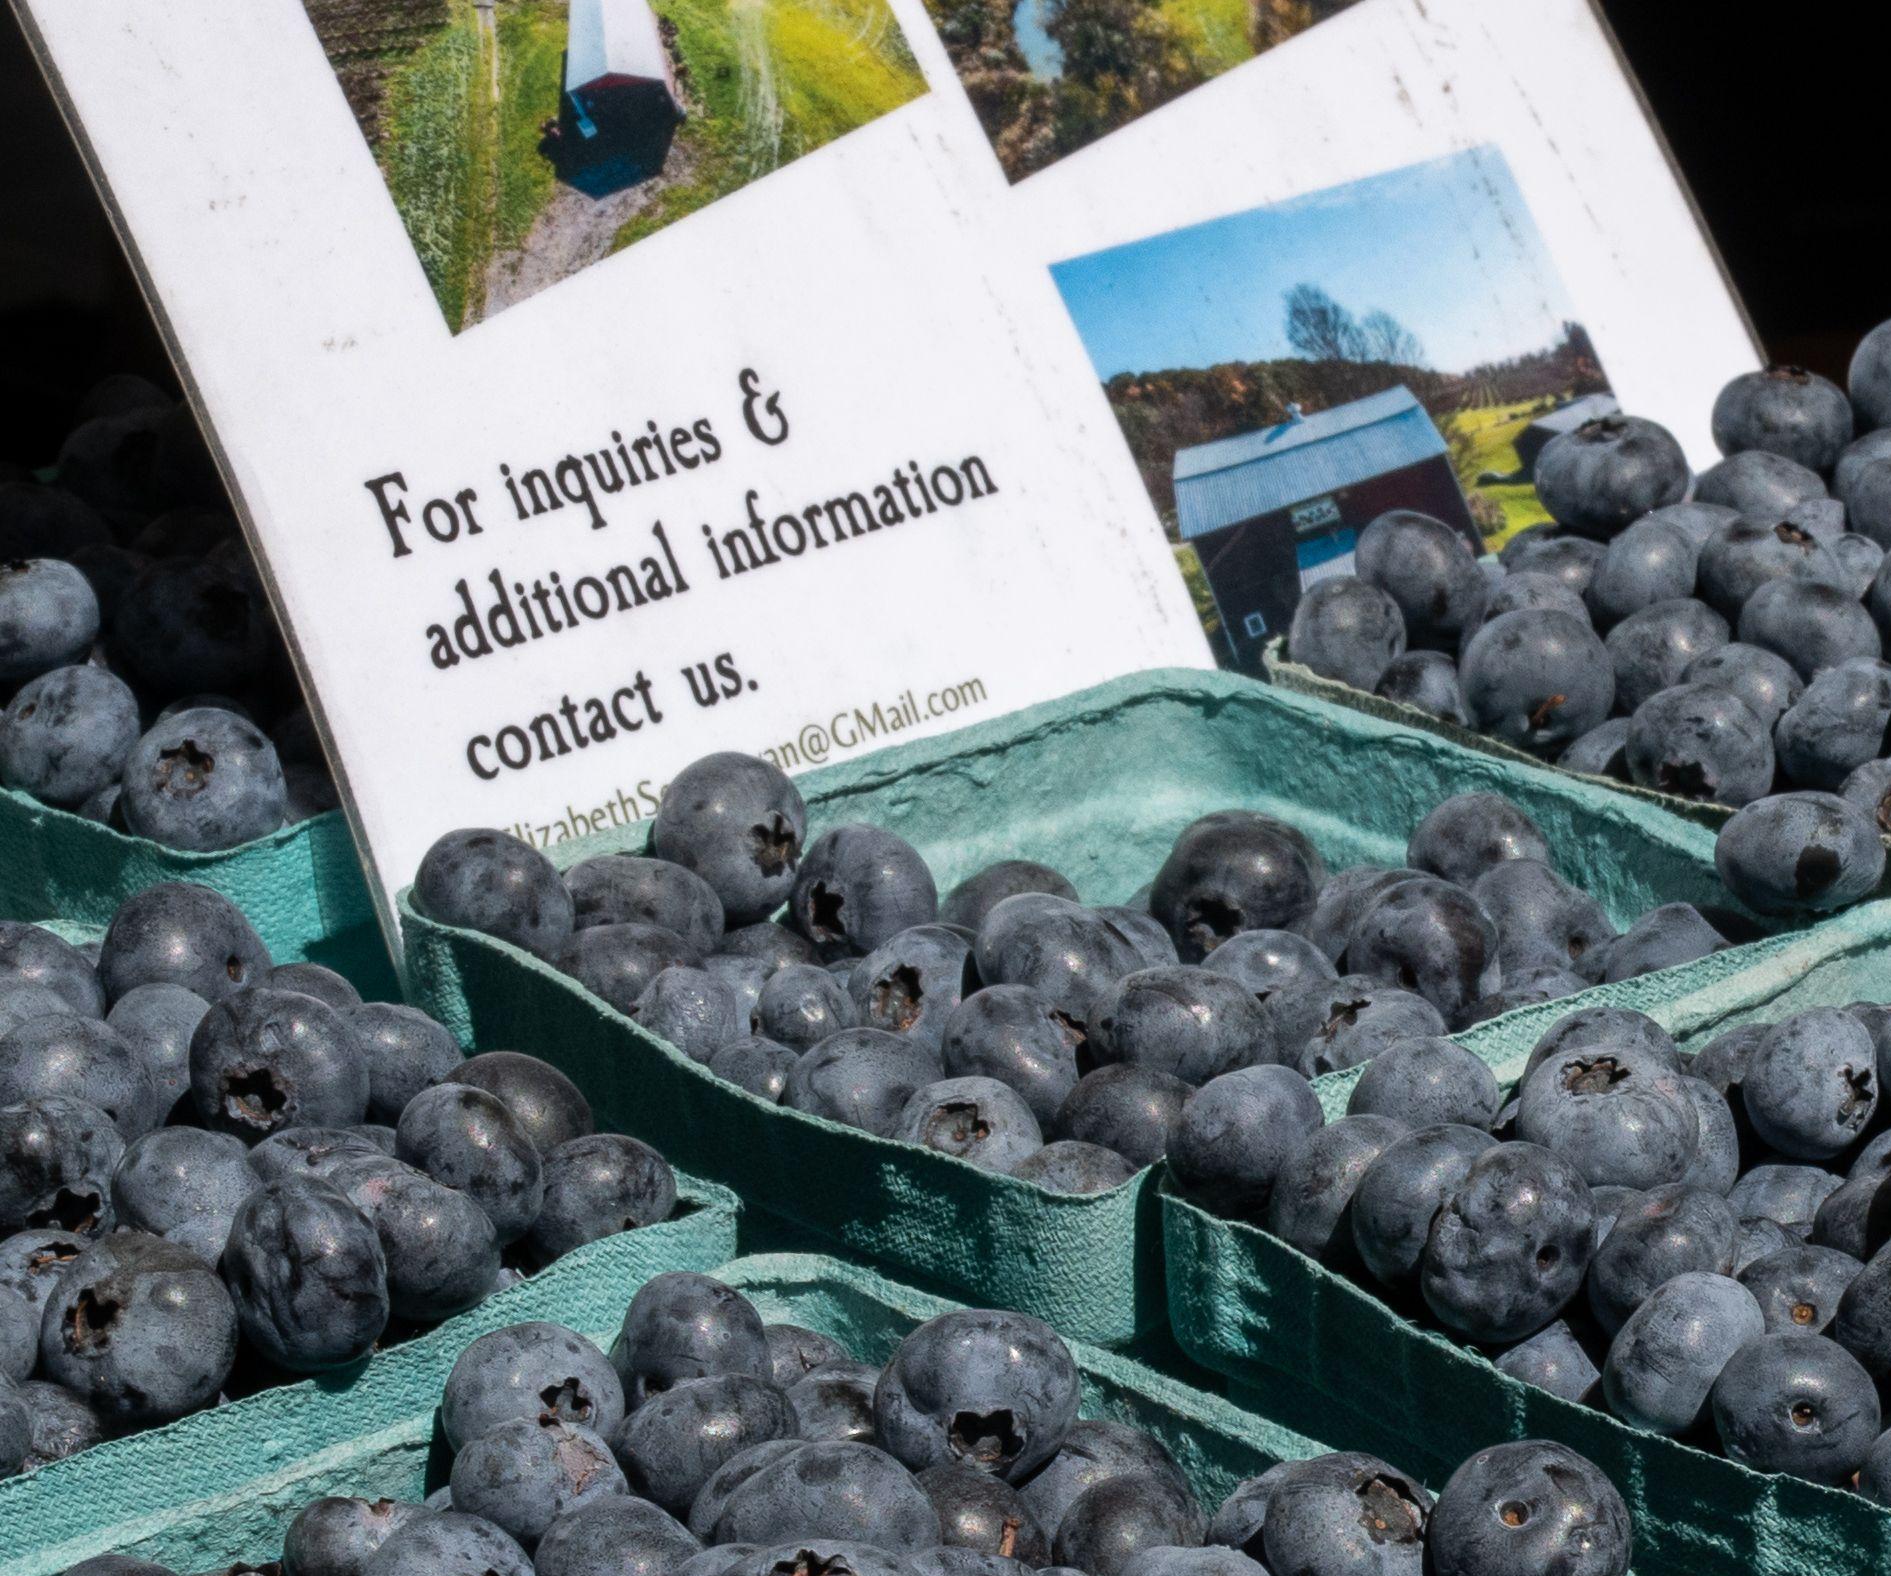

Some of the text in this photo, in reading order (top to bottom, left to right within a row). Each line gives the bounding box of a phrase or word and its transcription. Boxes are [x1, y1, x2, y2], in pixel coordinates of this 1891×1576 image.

[364, 367, 790, 559] For inquiries &
[425, 454, 1000, 670] additional information
[465, 652, 759, 781] contact us.
